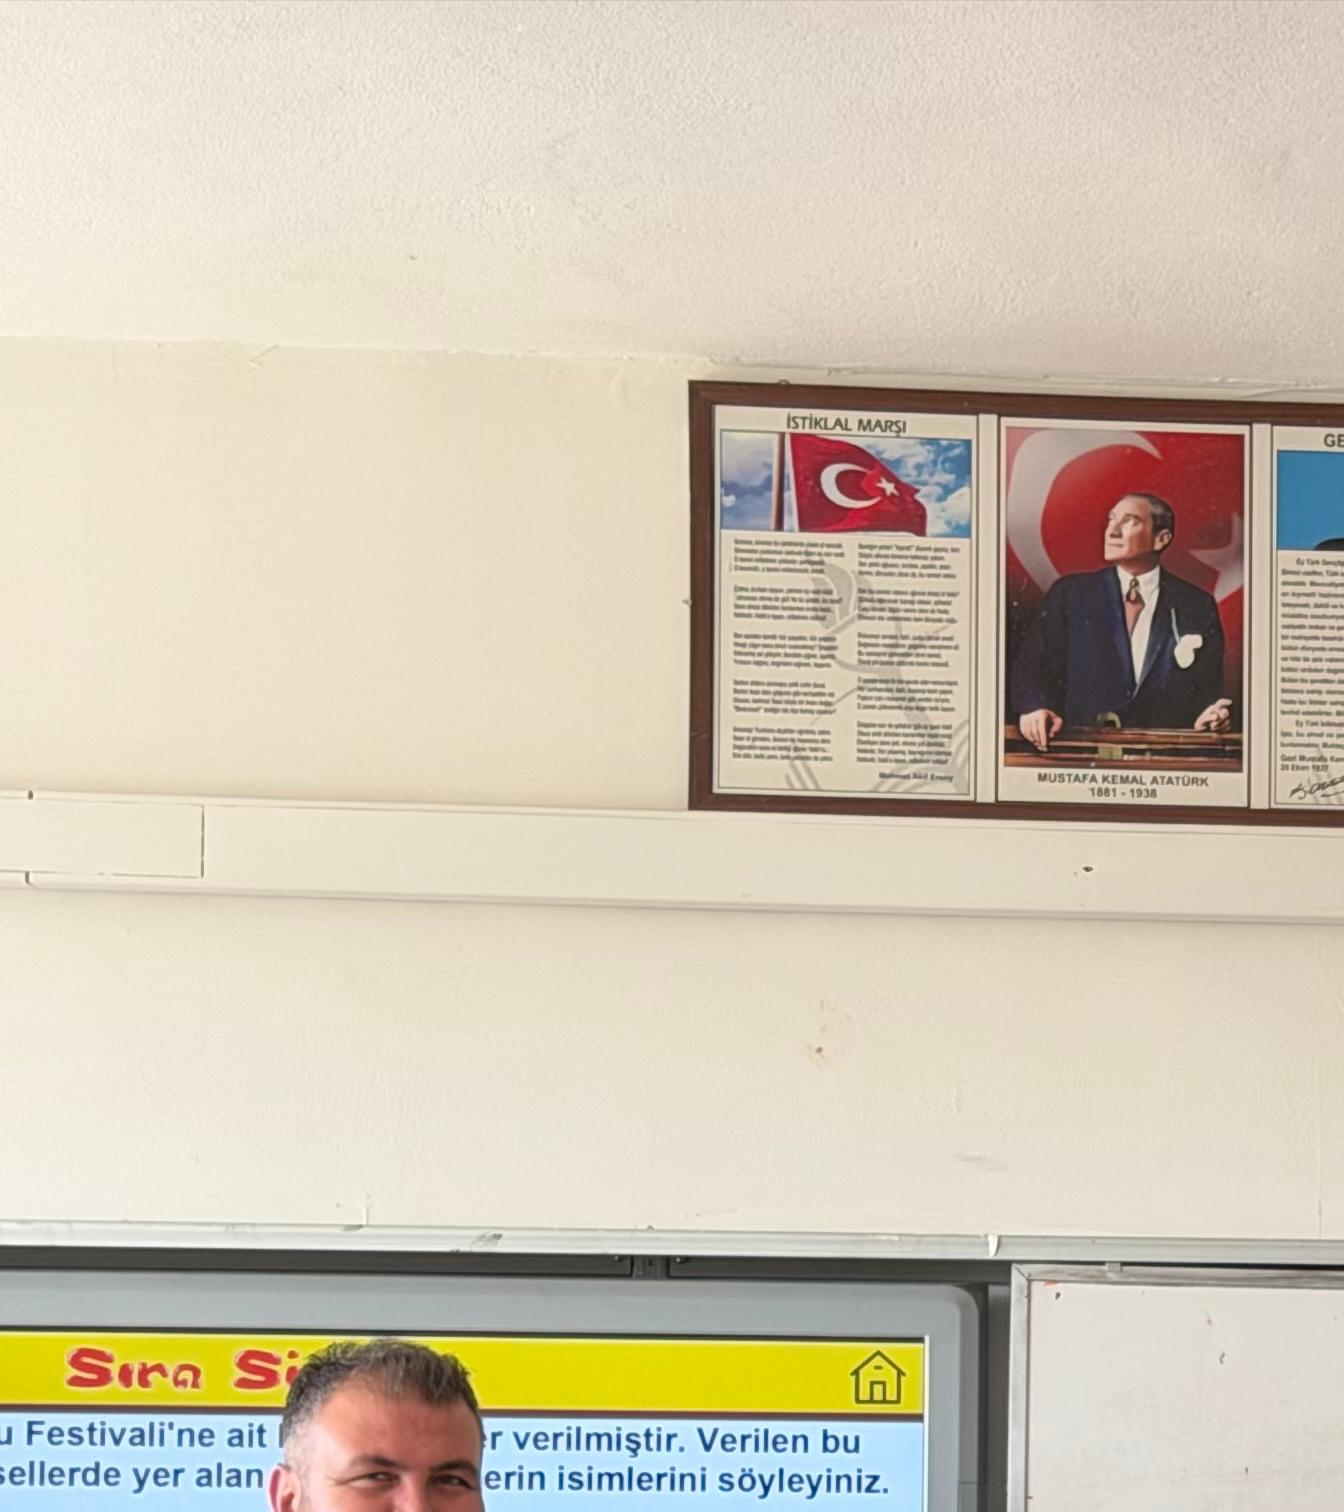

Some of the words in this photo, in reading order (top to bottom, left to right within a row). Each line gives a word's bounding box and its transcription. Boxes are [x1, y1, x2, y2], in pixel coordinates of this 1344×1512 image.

[786, 411, 853, 432] İSTİKLAL
[857, 418, 907, 438] MARŞI
[1037, 772, 1098, 785] MUSTAFA
[1101, 774, 1147, 786] KEMAL
[1150, 775, 1209, 787] ATATÜRK
[1089, 787, 1117, 798] 1881
[1129, 788, 1157, 799] 1938
[65, 1347, 203, 1389] Sıra
[26, 1420, 215, 1447] Festivali'ne
[227, 1423, 268, 1448] ait
[513, 1426, 686, 1458] verilmiştir.
[697, 1427, 809, 1453] Verilen
[821, 1429, 860, 1454] bu
[132, 1467, 185, 1494] yer
[195, 1462, 263, 1488] alan
[484, 1465, 545, 1490] erin
[557, 1465, 706, 1492] isimlerini
[718, 1468, 889, 1499] söyleyiniz.
